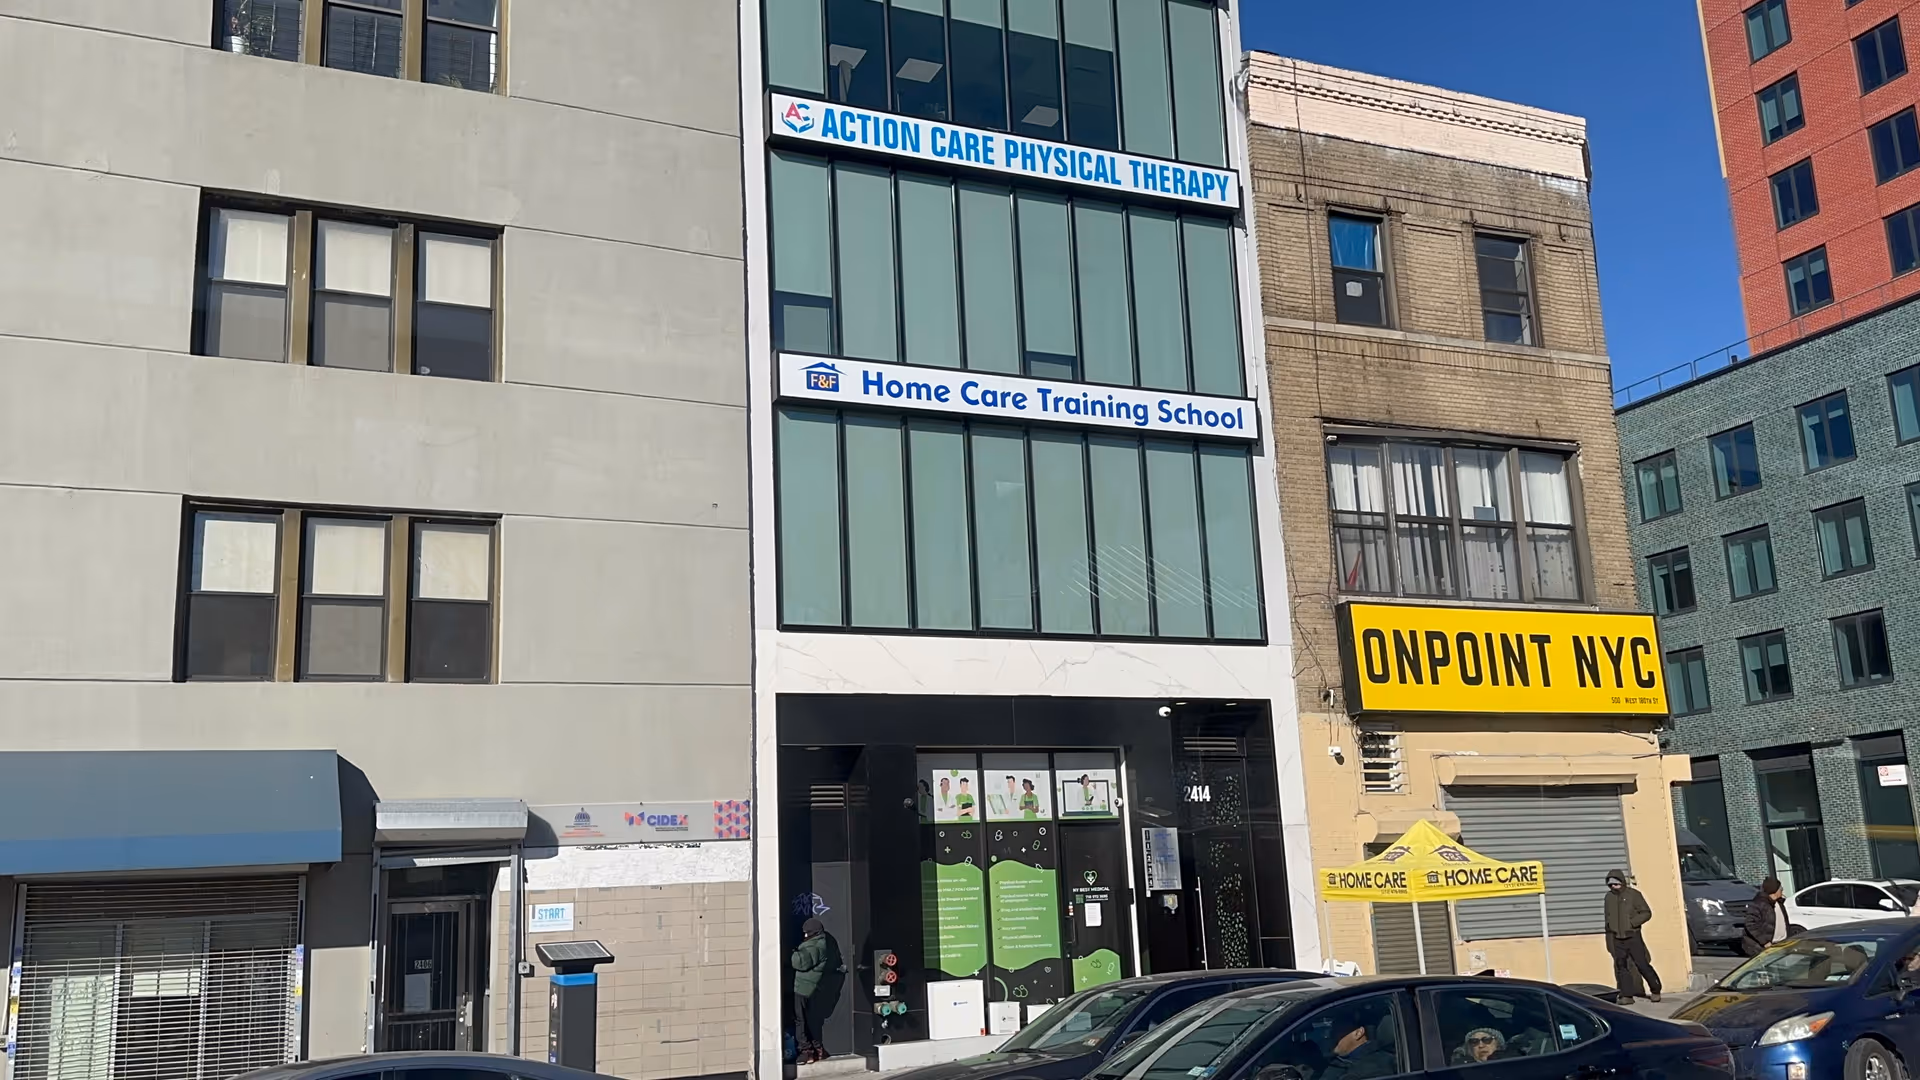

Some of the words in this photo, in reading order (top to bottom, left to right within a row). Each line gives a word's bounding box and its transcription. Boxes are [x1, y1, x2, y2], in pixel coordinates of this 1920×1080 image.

[821, 107, 921, 153] ACTION
[930, 126, 995, 166] CARE
[1004, 139, 1122, 186] PHYSICAL
[1129, 159, 1230, 202] THERAPY
[810, 373, 837, 389] F&F
[862, 370, 951, 404] Home
[960, 380, 1027, 411] Care
[1037, 388, 1149, 427] Training
[1157, 400, 1244, 430] School
[1362, 628, 1552, 688] ONPOINT
[1572, 635, 1656, 689] NYC
[1184, 785, 1211, 802] 2414
[647, 814, 689, 826] CIDEX
[1339, 872, 1372, 888] HOME
[1374, 872, 1407, 888] CARE
[1445, 868, 1493, 886] HOME
[1495, 866, 1538, 883] CARE
[538, 907, 566, 919] START
